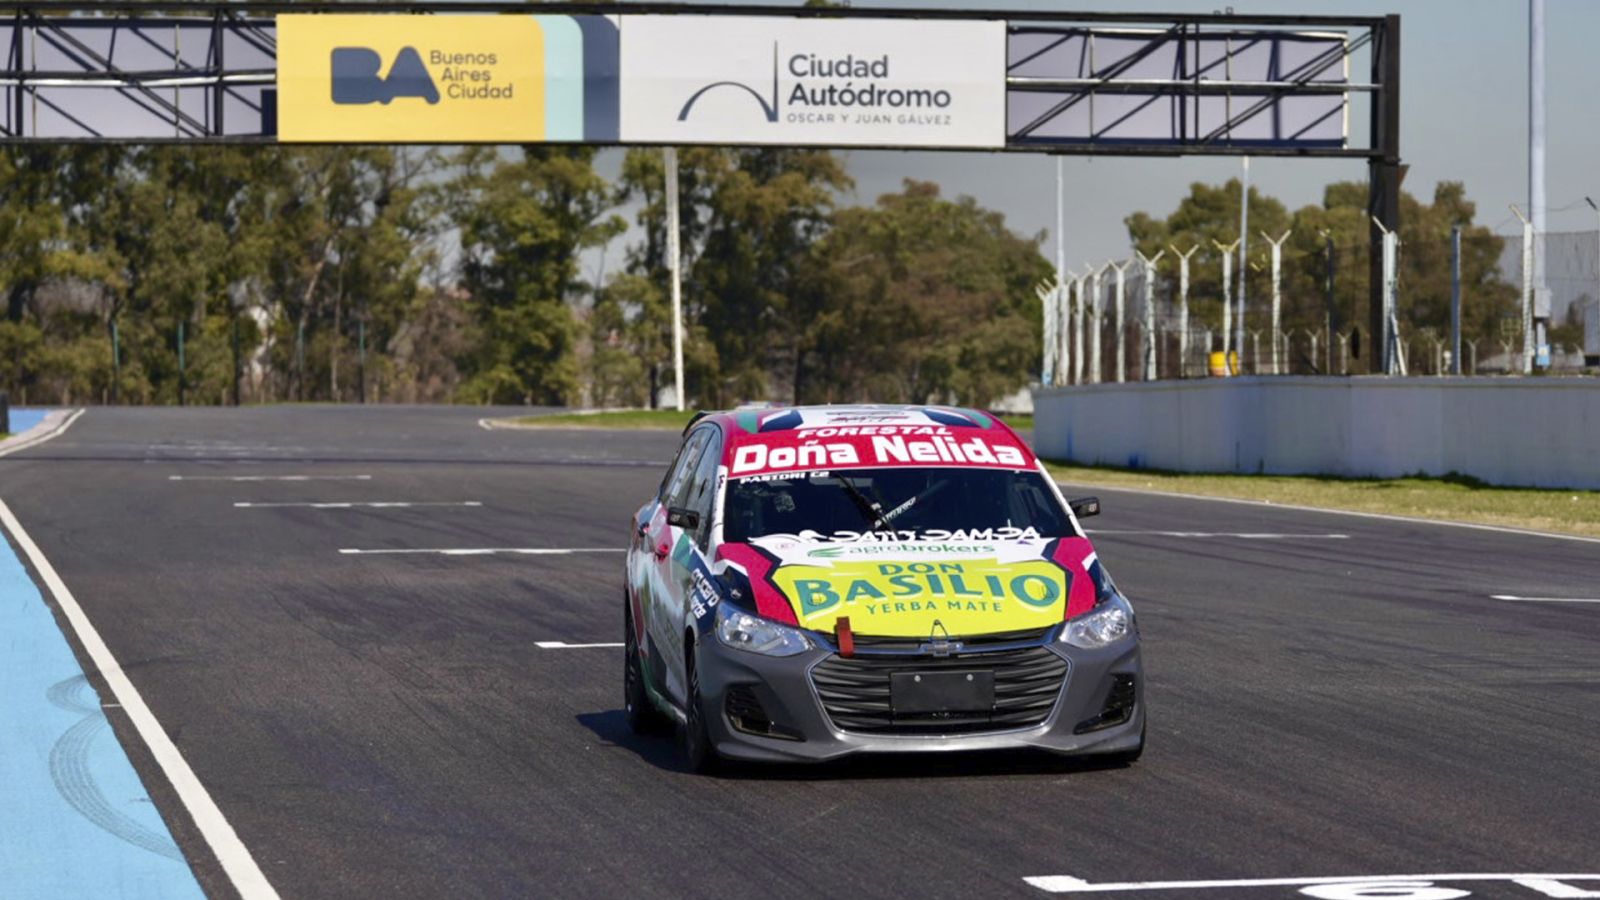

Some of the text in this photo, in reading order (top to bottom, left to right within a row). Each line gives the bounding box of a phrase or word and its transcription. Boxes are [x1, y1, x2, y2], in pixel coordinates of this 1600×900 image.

[430, 50, 498, 65] Buenos
[788, 53, 889, 79] Ciudad
[330, 46, 440, 105] BA
[441, 67, 492, 83] Aires
[447, 83, 513, 99] Ciudad
[788, 82, 952, 109] Autódromo
[788, 111, 953, 125] OSCAR Y JUAN GÁLVEZ
[797, 425, 954, 439] FORESTAL
[732, 434, 1026, 474] Doña Nelida
[849, 543, 996, 557] agrobrokers
[878, 563, 965, 577] DON
[793, 573, 1061, 617] BASILIO
[866, 601, 1003, 615] YERBA MATE
